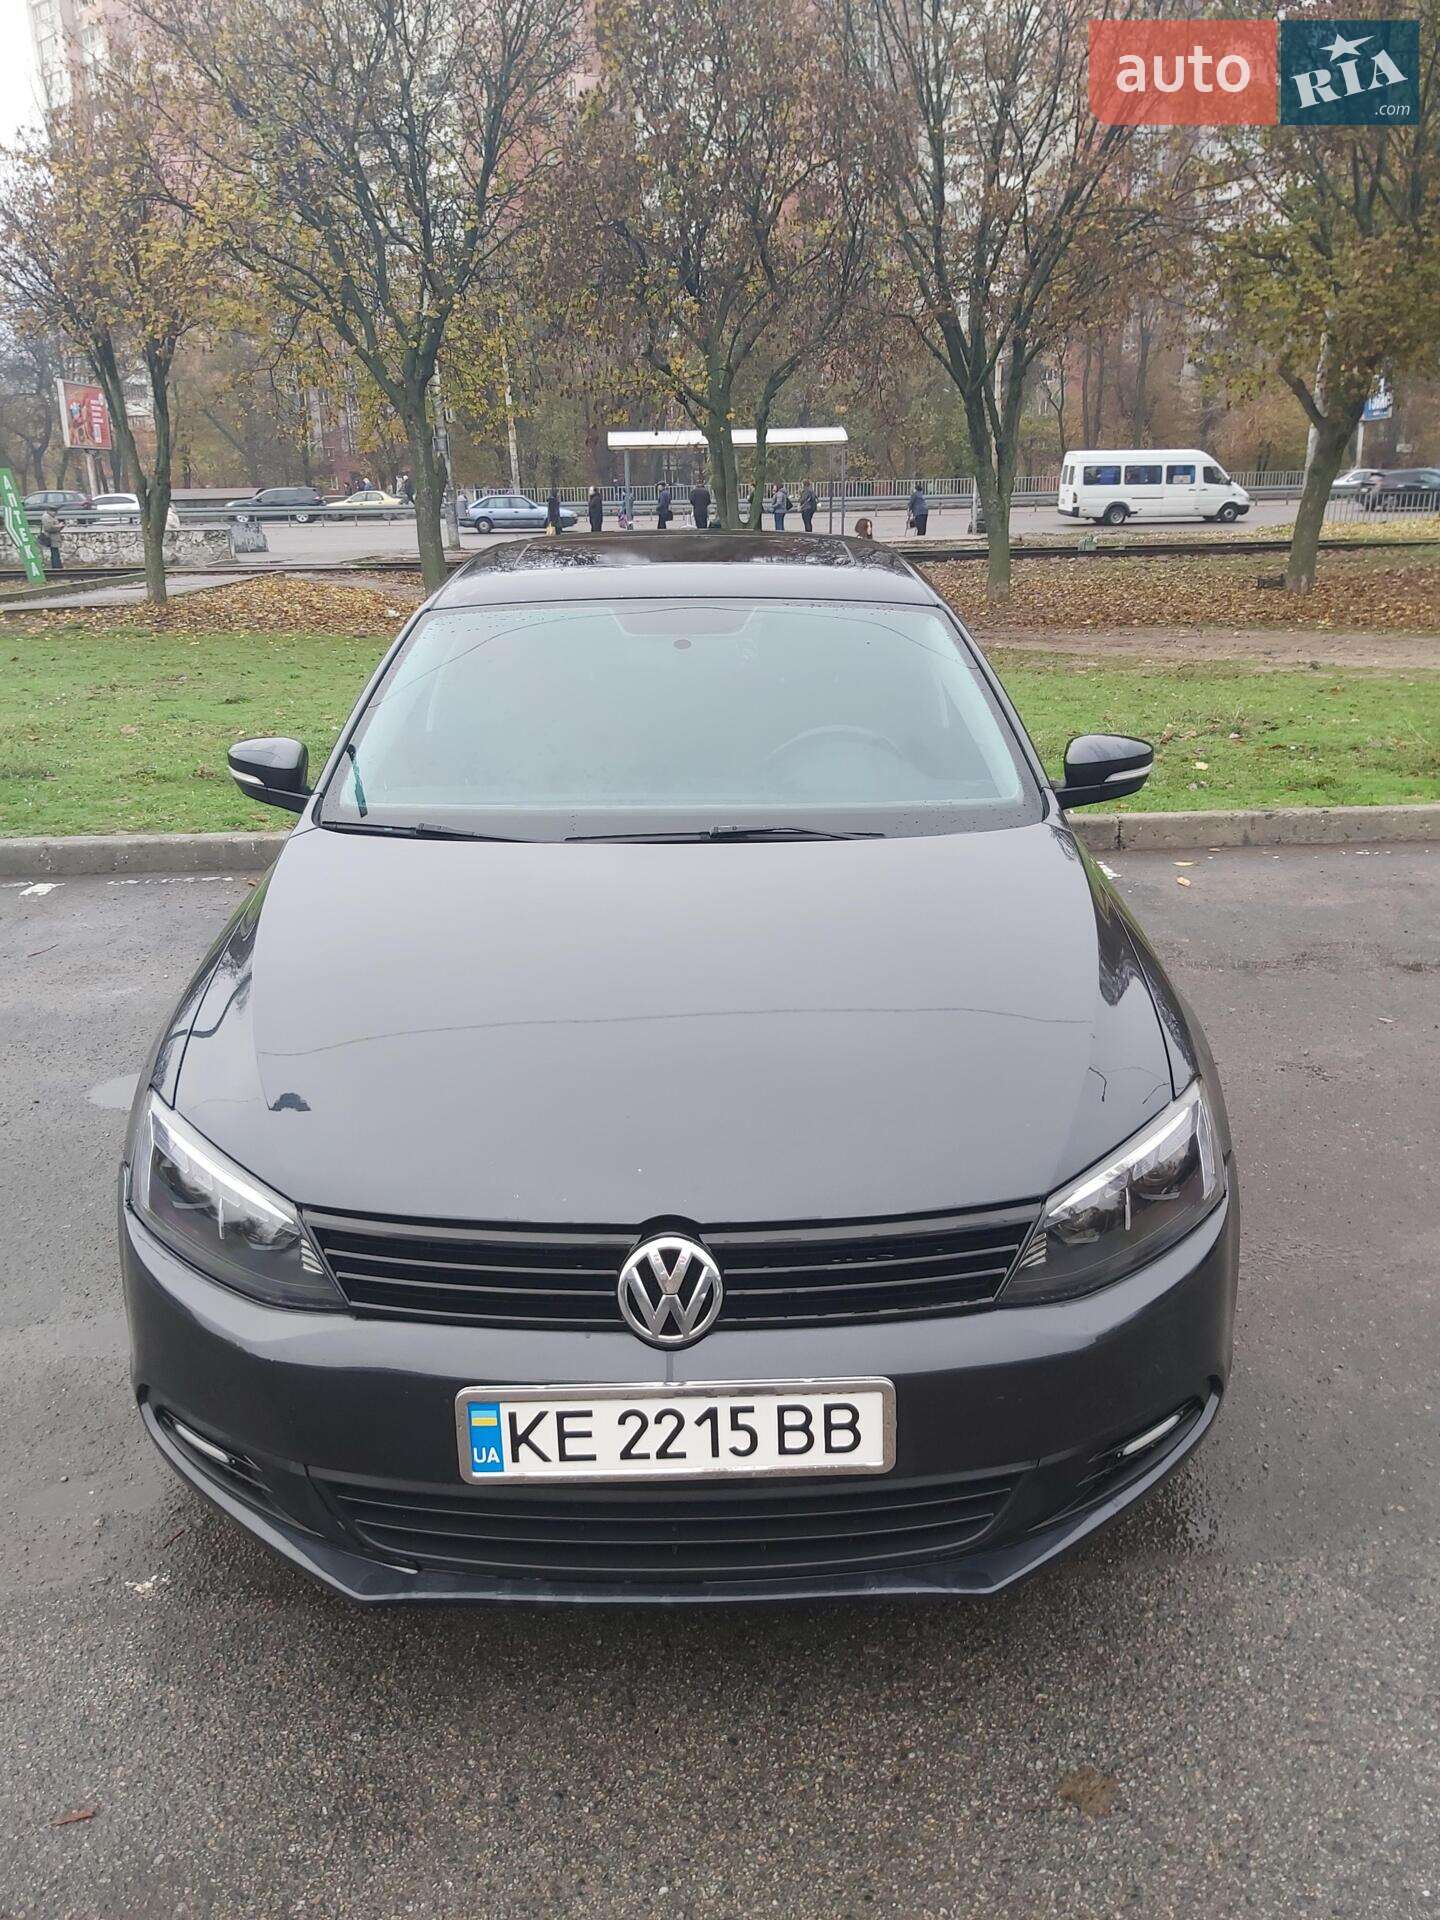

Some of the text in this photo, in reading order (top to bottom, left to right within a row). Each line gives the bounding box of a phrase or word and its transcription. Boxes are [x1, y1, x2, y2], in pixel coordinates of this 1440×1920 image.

[508, 1402, 862, 1463] KE 2215 BB
[473, 1447, 500, 1463] UA
